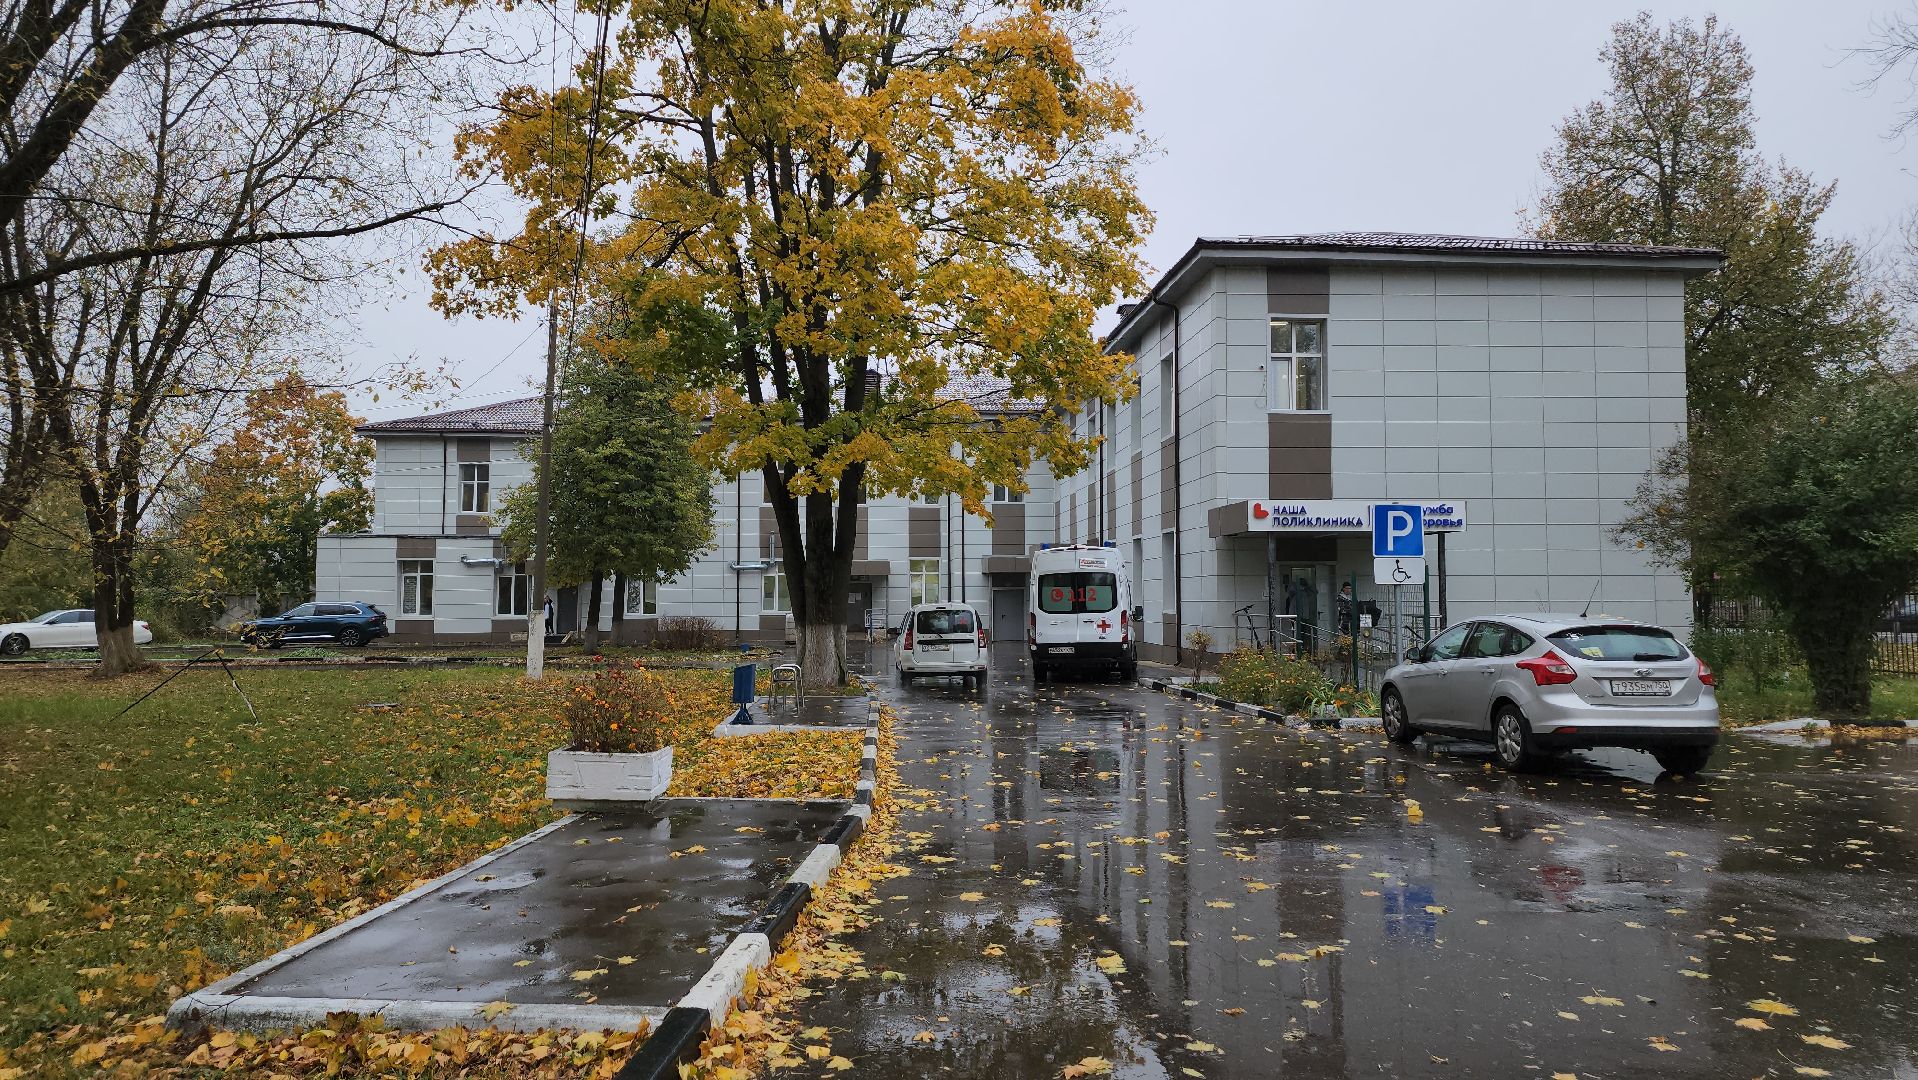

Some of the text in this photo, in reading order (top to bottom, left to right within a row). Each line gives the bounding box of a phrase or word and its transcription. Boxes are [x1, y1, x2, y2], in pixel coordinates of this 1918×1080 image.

[1273, 505, 1307, 515] НАША
[1423, 504, 1454, 516] ужба
[1273, 516, 1364, 527] ПОЛИКЛИНИКА
[1423, 518, 1463, 528] оровья
[1387, 510, 1413, 551] P
[1068, 587, 1097, 602] 112
